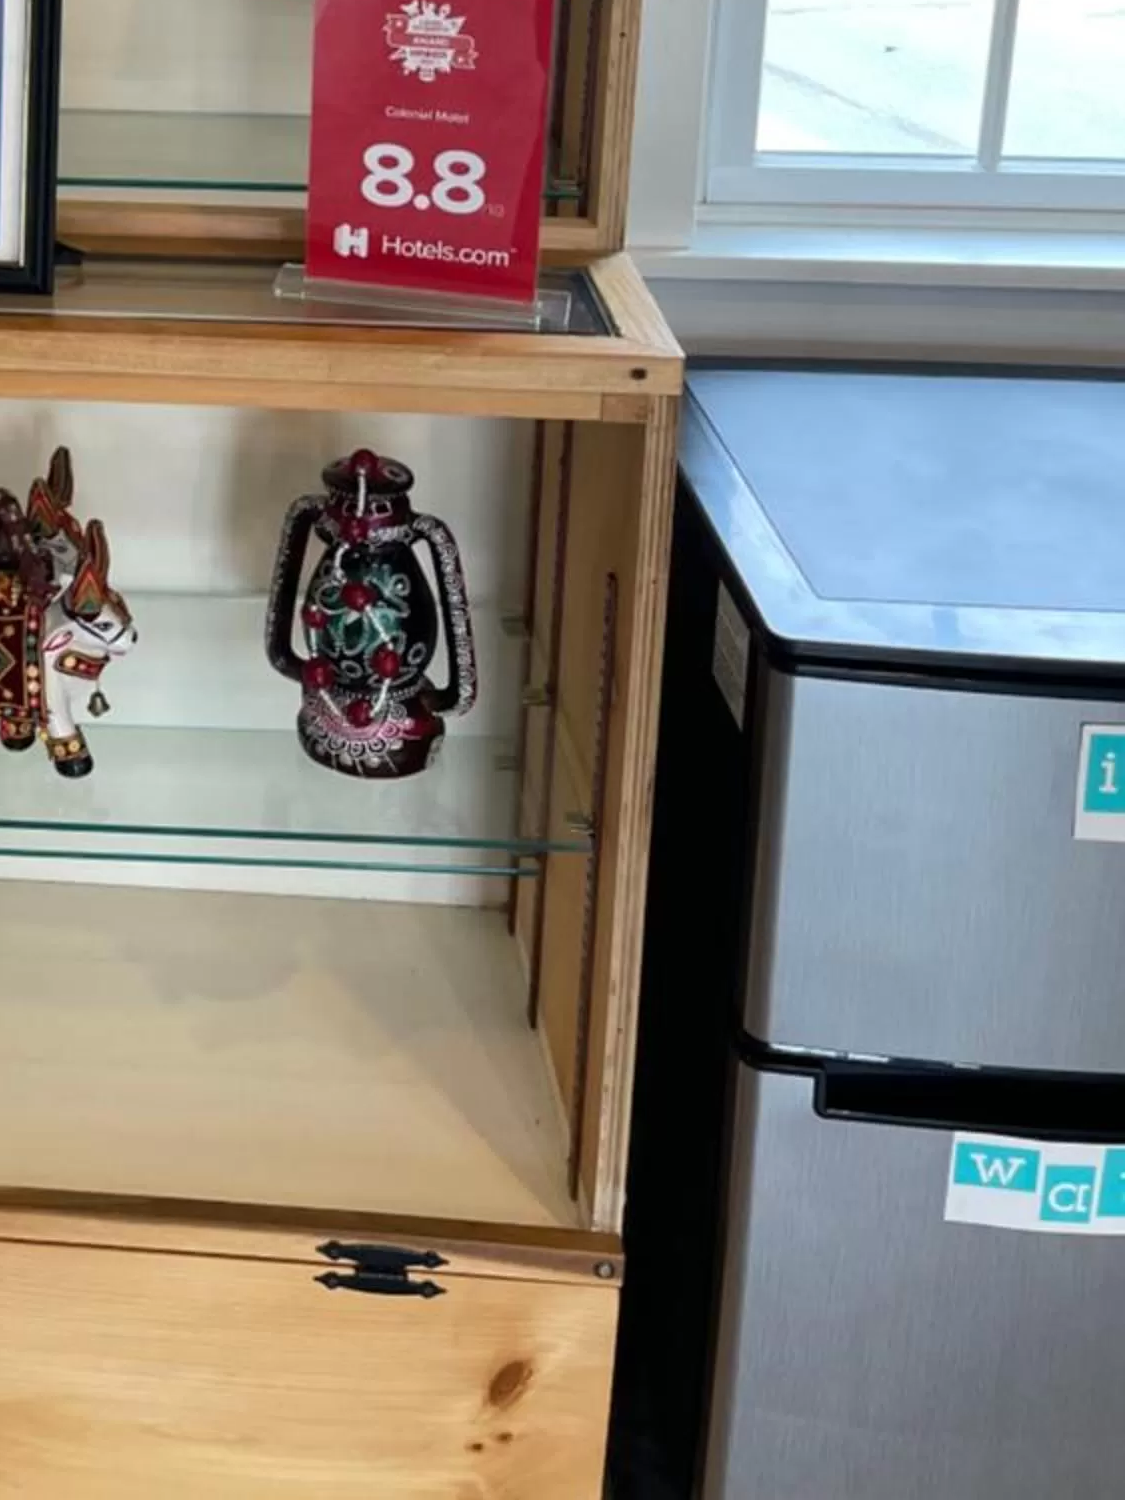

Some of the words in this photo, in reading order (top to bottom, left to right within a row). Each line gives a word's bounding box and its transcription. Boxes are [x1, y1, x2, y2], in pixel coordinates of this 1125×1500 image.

[385, 105, 433, 120] Colonial
[435, 110, 470, 125] Motel
[361, 143, 486, 214] 8.8
[382, 235, 510, 267] Hotels.com
